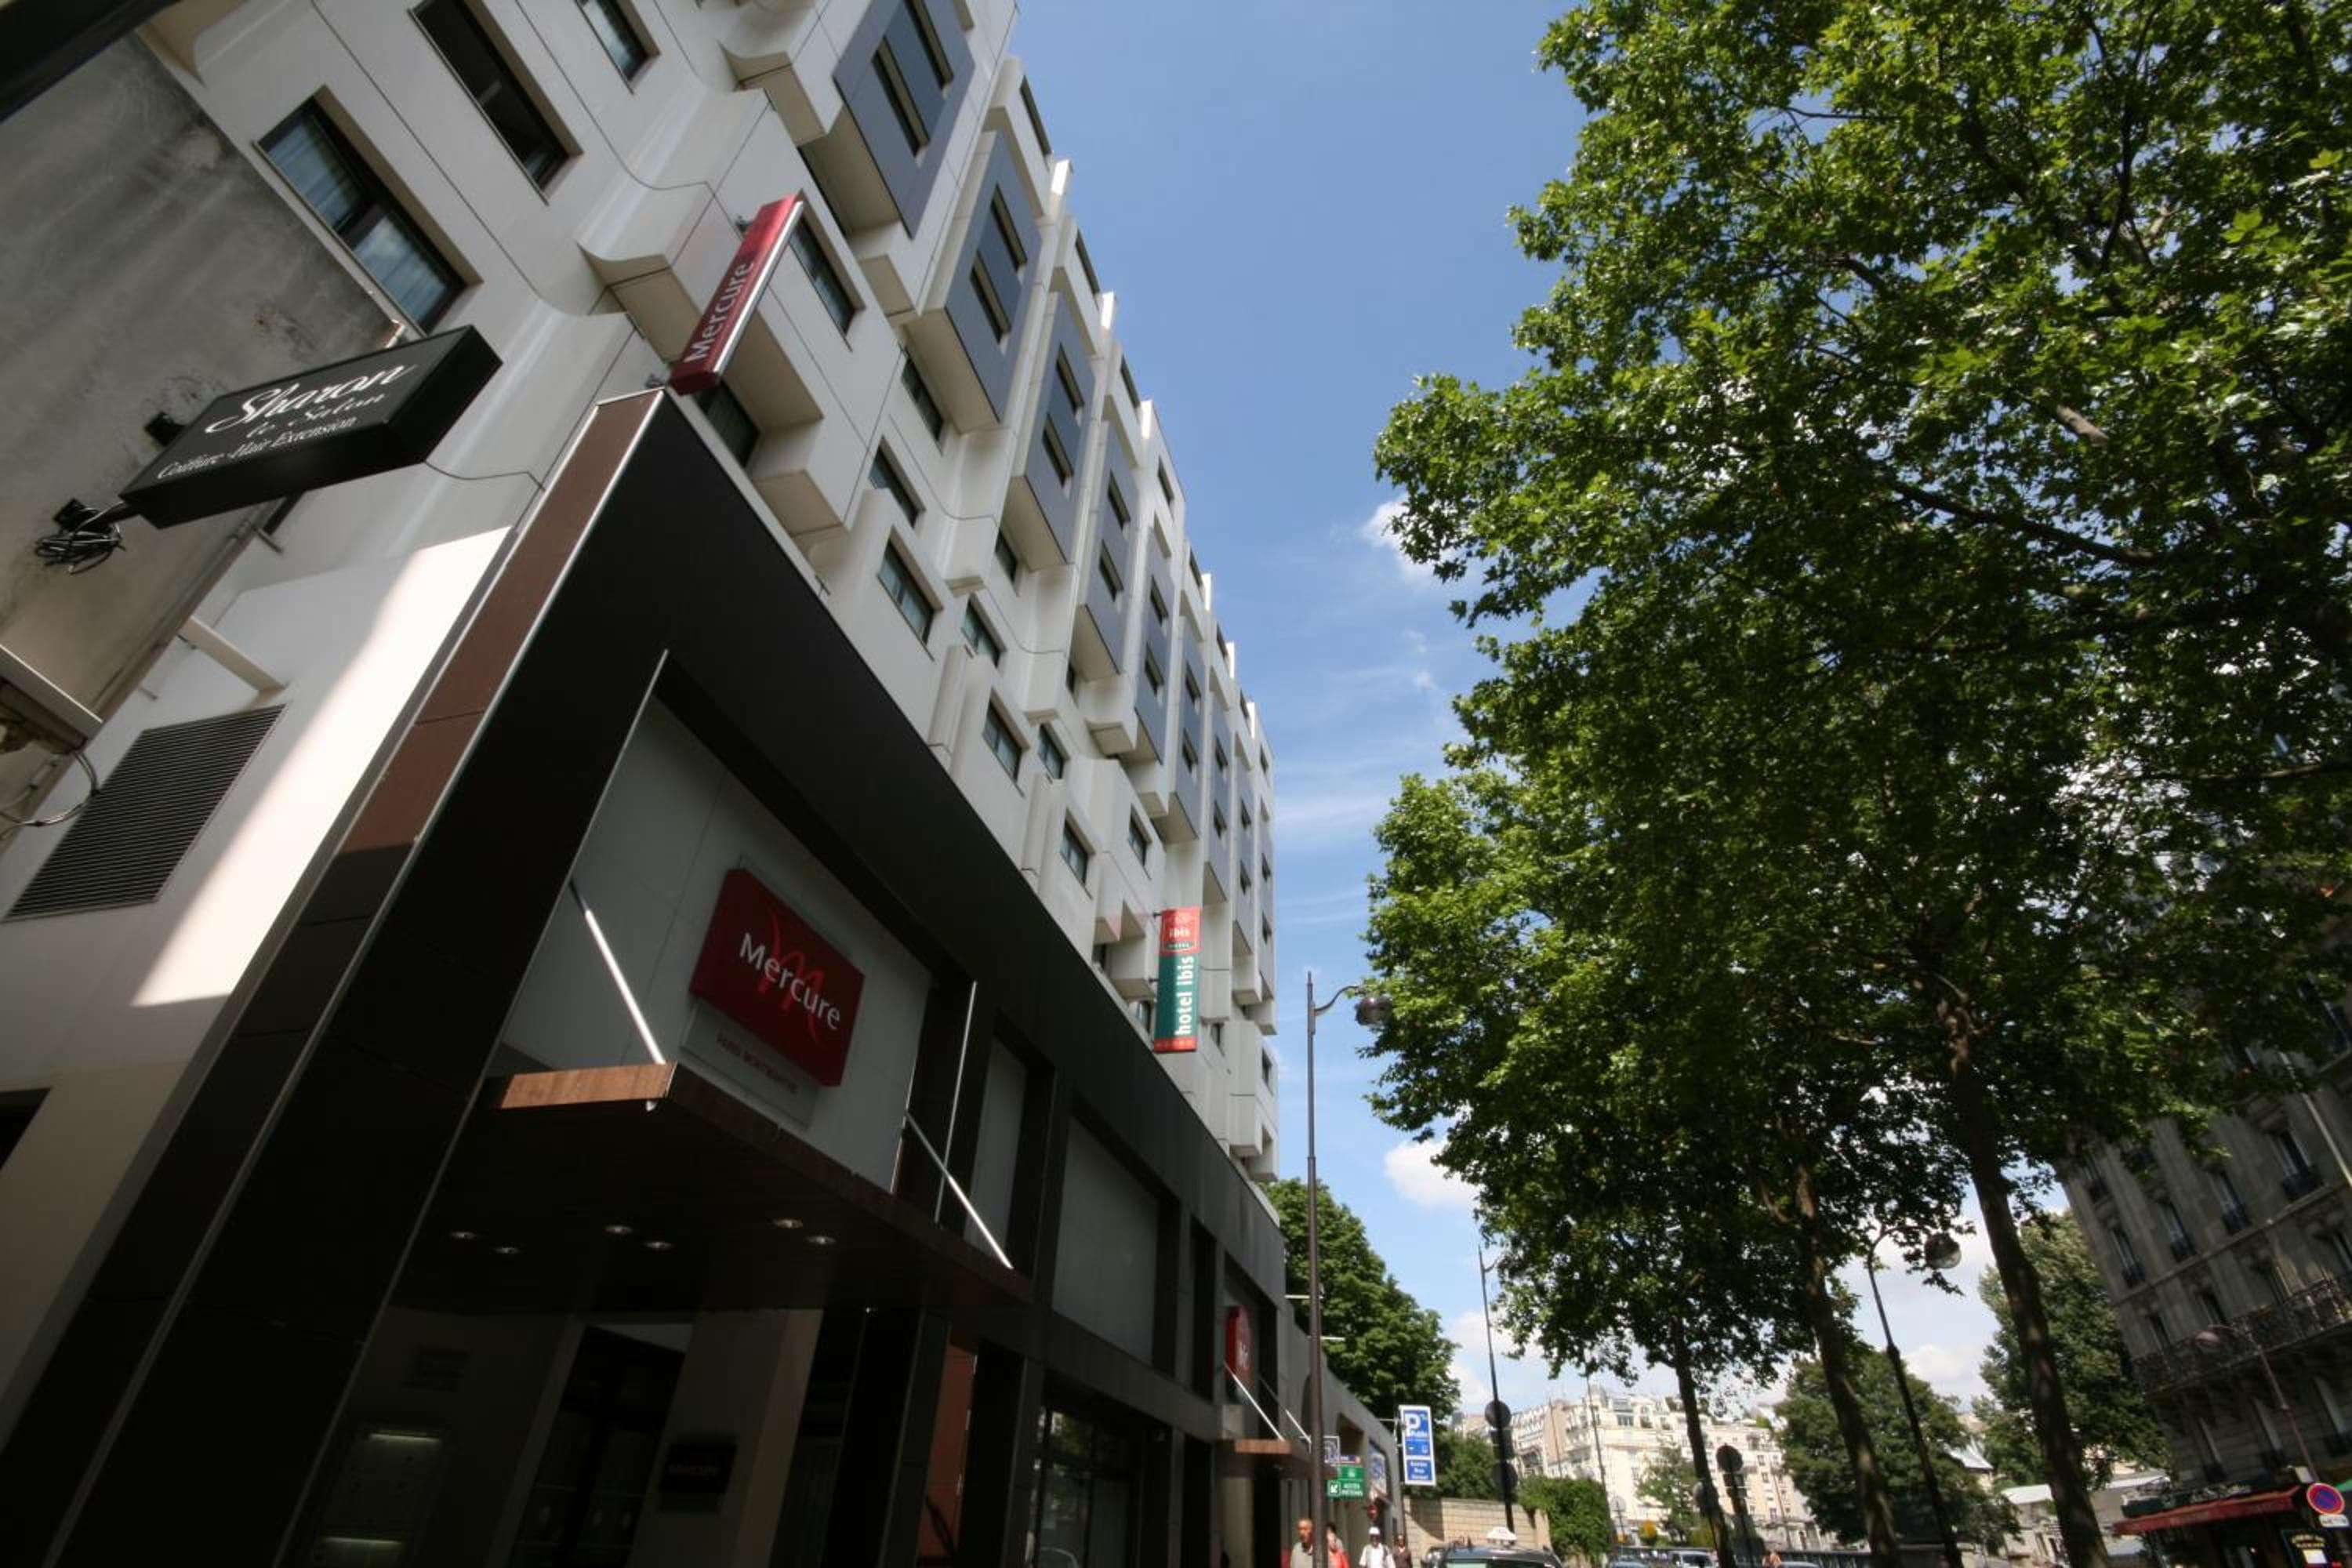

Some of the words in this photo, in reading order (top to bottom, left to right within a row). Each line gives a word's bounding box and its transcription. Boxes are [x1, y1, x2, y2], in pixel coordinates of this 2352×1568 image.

[683, 261, 755, 362] Mercure
[205, 364, 411, 433] Sharon
[270, 416, 358, 449] Extension
[739, 931, 841, 1031] Mercure
[1174, 992, 1193, 1036] hotel
[1405, 1414, 1421, 1437] P
